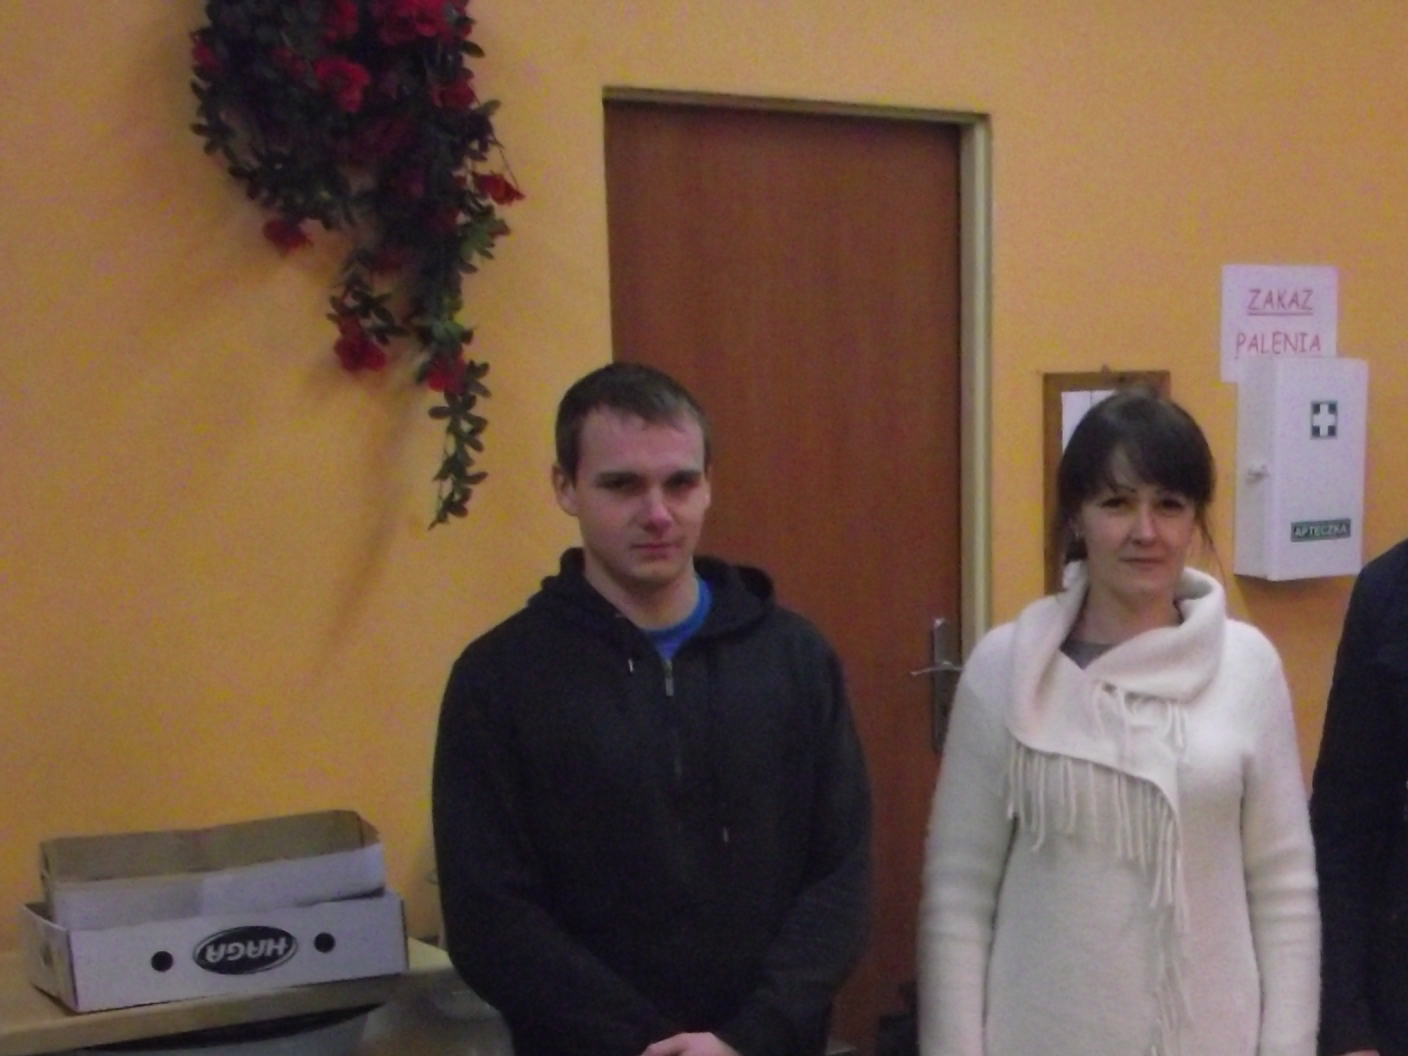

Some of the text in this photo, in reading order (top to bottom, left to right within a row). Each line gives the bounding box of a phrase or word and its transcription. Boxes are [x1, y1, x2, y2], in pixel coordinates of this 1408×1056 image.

[1247, 288, 1314, 311] ZAKAZ
[1235, 331, 1321, 359] PALENIA
[1293, 522, 1348, 538] APTECZKA
[204, 936, 289, 964] HAGA
